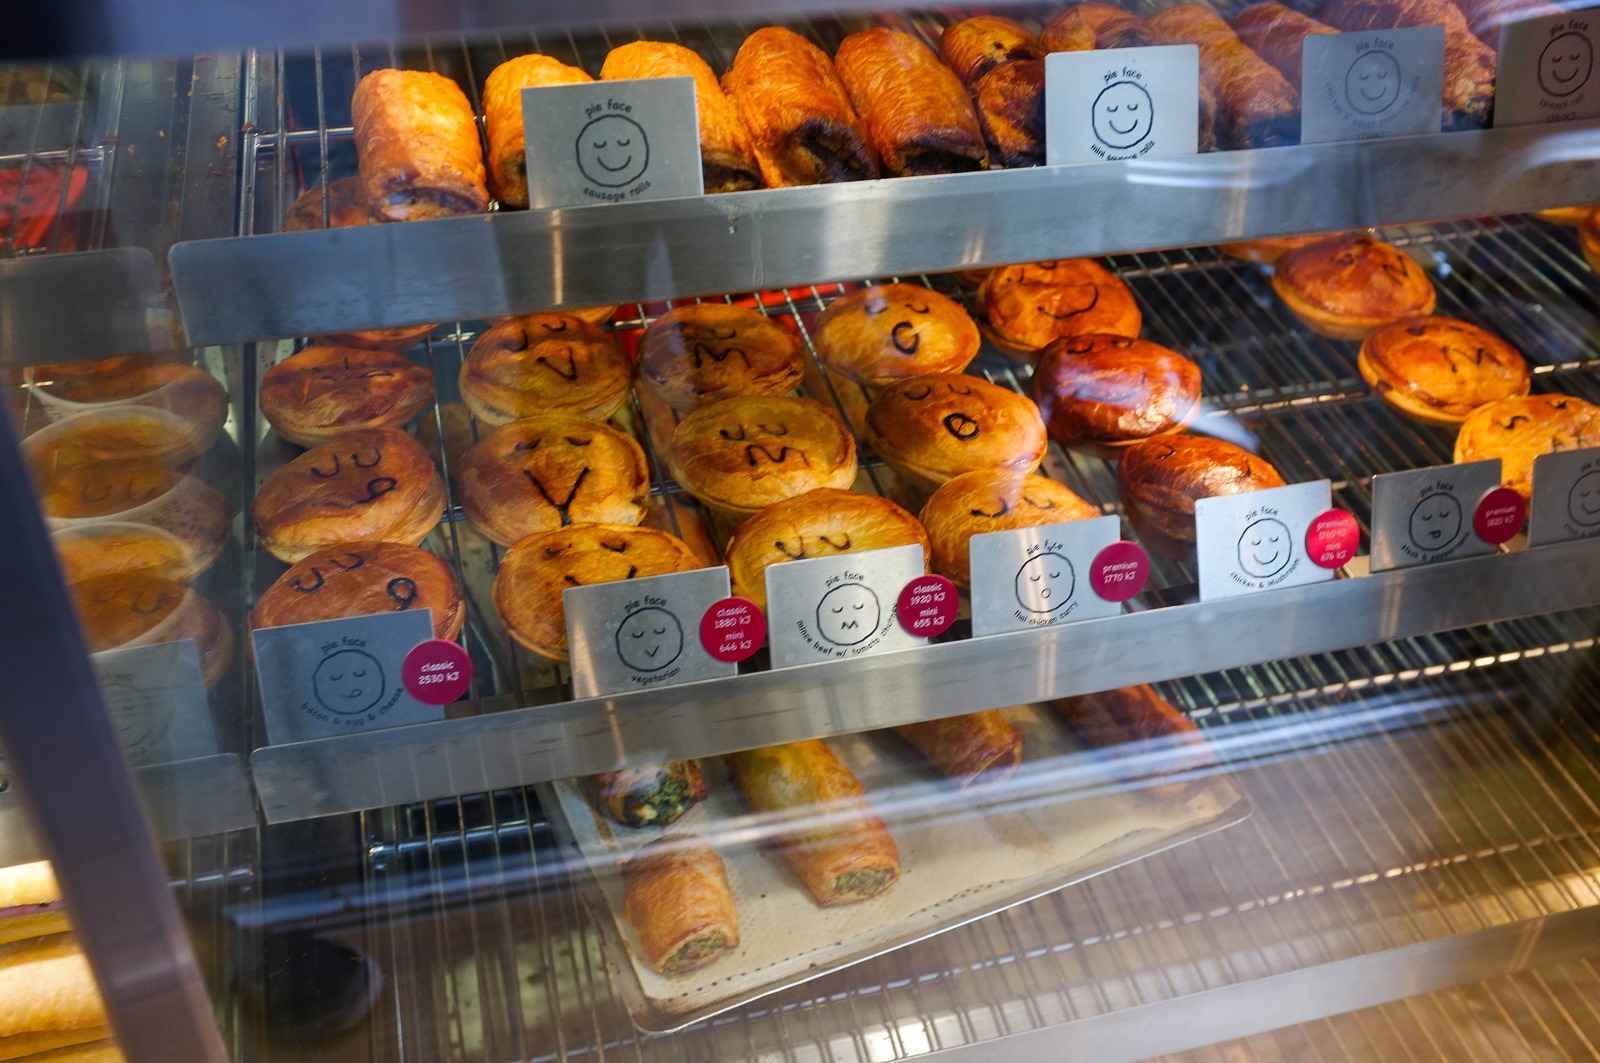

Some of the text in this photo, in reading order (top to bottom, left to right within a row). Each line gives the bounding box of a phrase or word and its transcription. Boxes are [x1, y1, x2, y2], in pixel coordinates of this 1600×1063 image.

[1122, 66, 1142, 80] face
[586, 98, 632, 119] pie face
[1090, 143, 1106, 158] mini
[582, 180, 652, 202] sausage rolls
[1437, 481, 1454, 492] face
[1262, 506, 1279, 516] face
[1485, 506, 1518, 518] premium
[1102, 561, 1138, 575] premium
[825, 570, 865, 588] pie face
[1104, 572, 1124, 584] 1770
[912, 582, 943, 595] classic
[624, 594, 668, 614] pie face
[910, 594, 932, 606] 1920
[716, 605, 748, 618] classic
[920, 606, 938, 618] mini
[714, 616, 738, 629] 1880
[725, 631, 745, 642] mini
[796, 620, 813, 643] mince
[814, 641, 833, 656] beef
[320, 635, 368, 655] pie face
[420, 660, 455, 673] classic
[418, 672, 445, 686] 2530
[631, 666, 682, 686] vegetarian
[301, 702, 329, 722] bacon
[345, 718, 365, 730] egg
